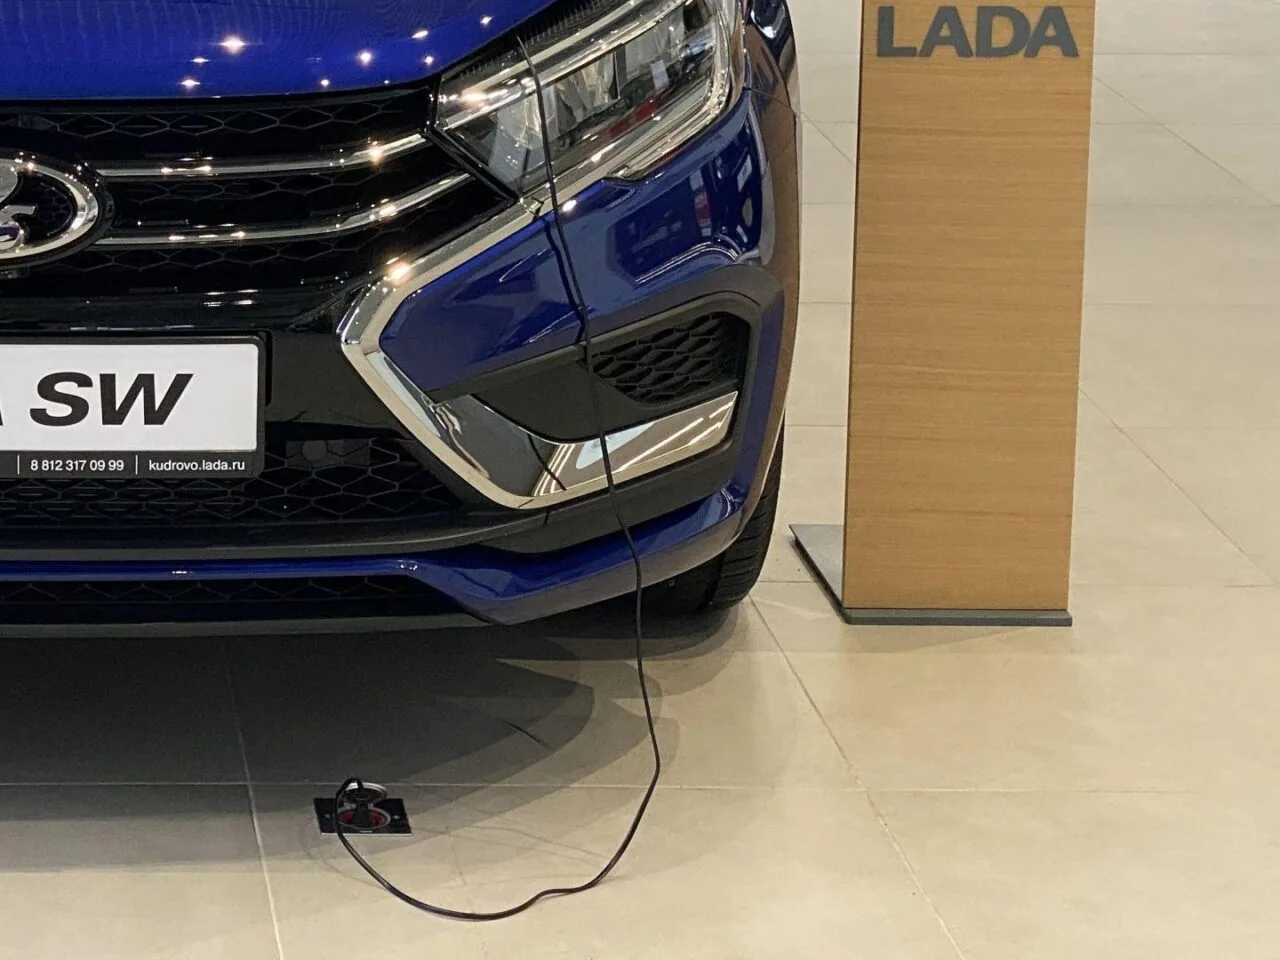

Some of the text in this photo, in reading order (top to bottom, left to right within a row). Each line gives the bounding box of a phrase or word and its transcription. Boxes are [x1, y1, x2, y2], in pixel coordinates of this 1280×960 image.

[876, 5, 1080, 58] LADA
[29, 371, 194, 427] SW
[30, 459, 125, 471] 8 812 317 09 99
[148, 459, 246, 471] kudrovo.lada.ru
